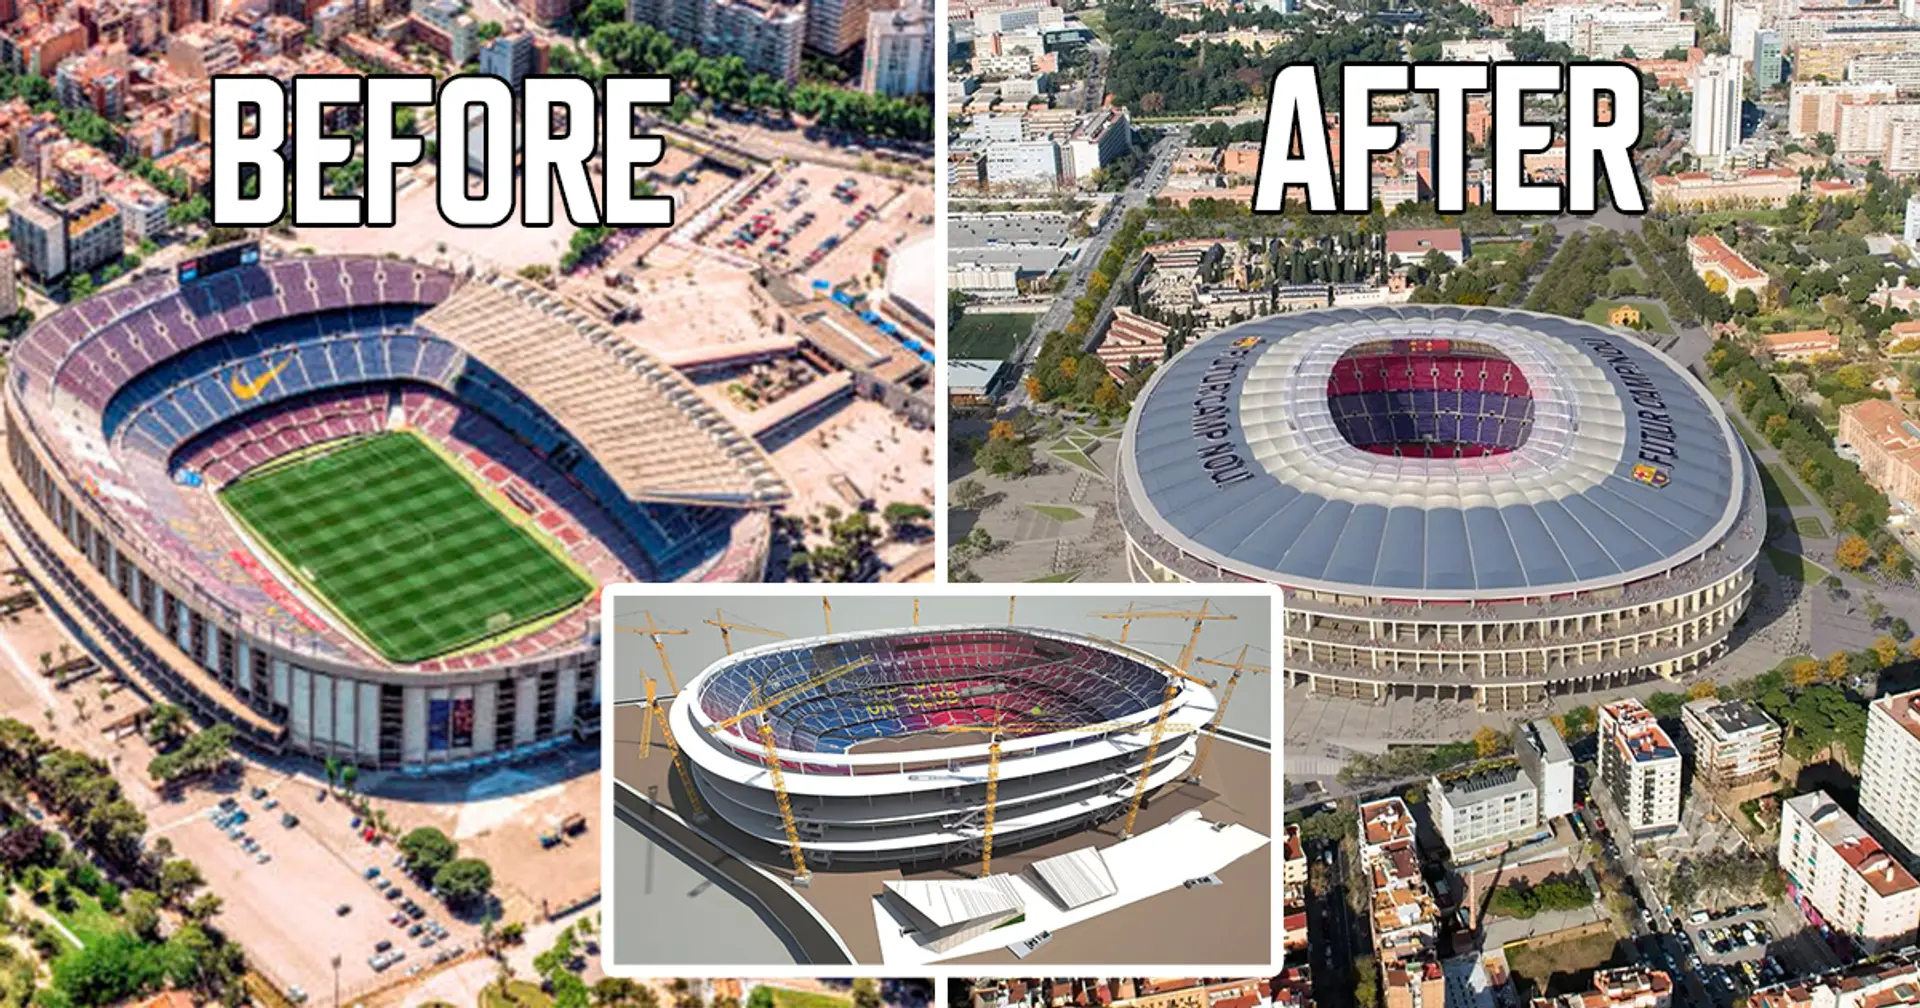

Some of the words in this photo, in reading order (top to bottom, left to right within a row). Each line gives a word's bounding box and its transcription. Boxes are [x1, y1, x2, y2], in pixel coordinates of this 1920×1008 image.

[1613, 364, 1668, 410] CAMP
[1193, 395, 1230, 439] CAMP
[1637, 409, 1678, 470] FUTUR
[907, 690, 959, 709] CLUB
